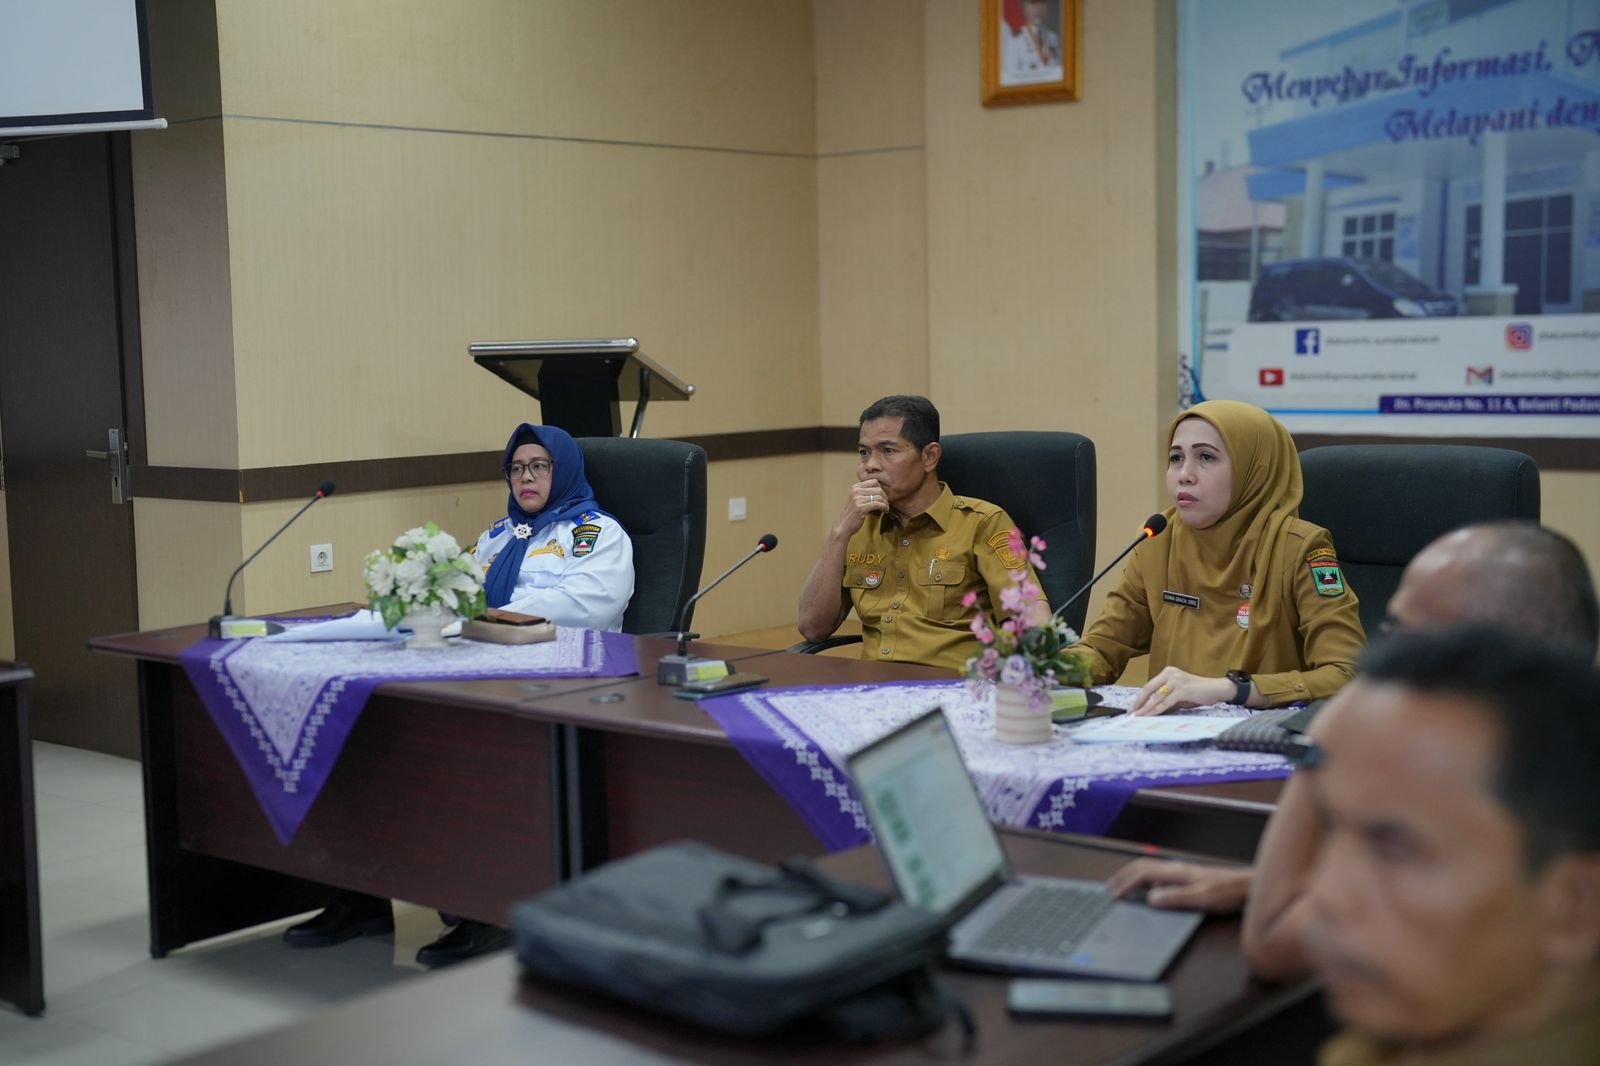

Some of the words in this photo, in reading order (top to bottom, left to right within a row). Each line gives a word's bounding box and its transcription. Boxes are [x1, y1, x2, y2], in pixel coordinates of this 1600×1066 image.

[1242, 68, 1387, 106] Menyebar
[1385, 100, 1538, 145] Melayani
[848, 552, 888, 566] RUDY
